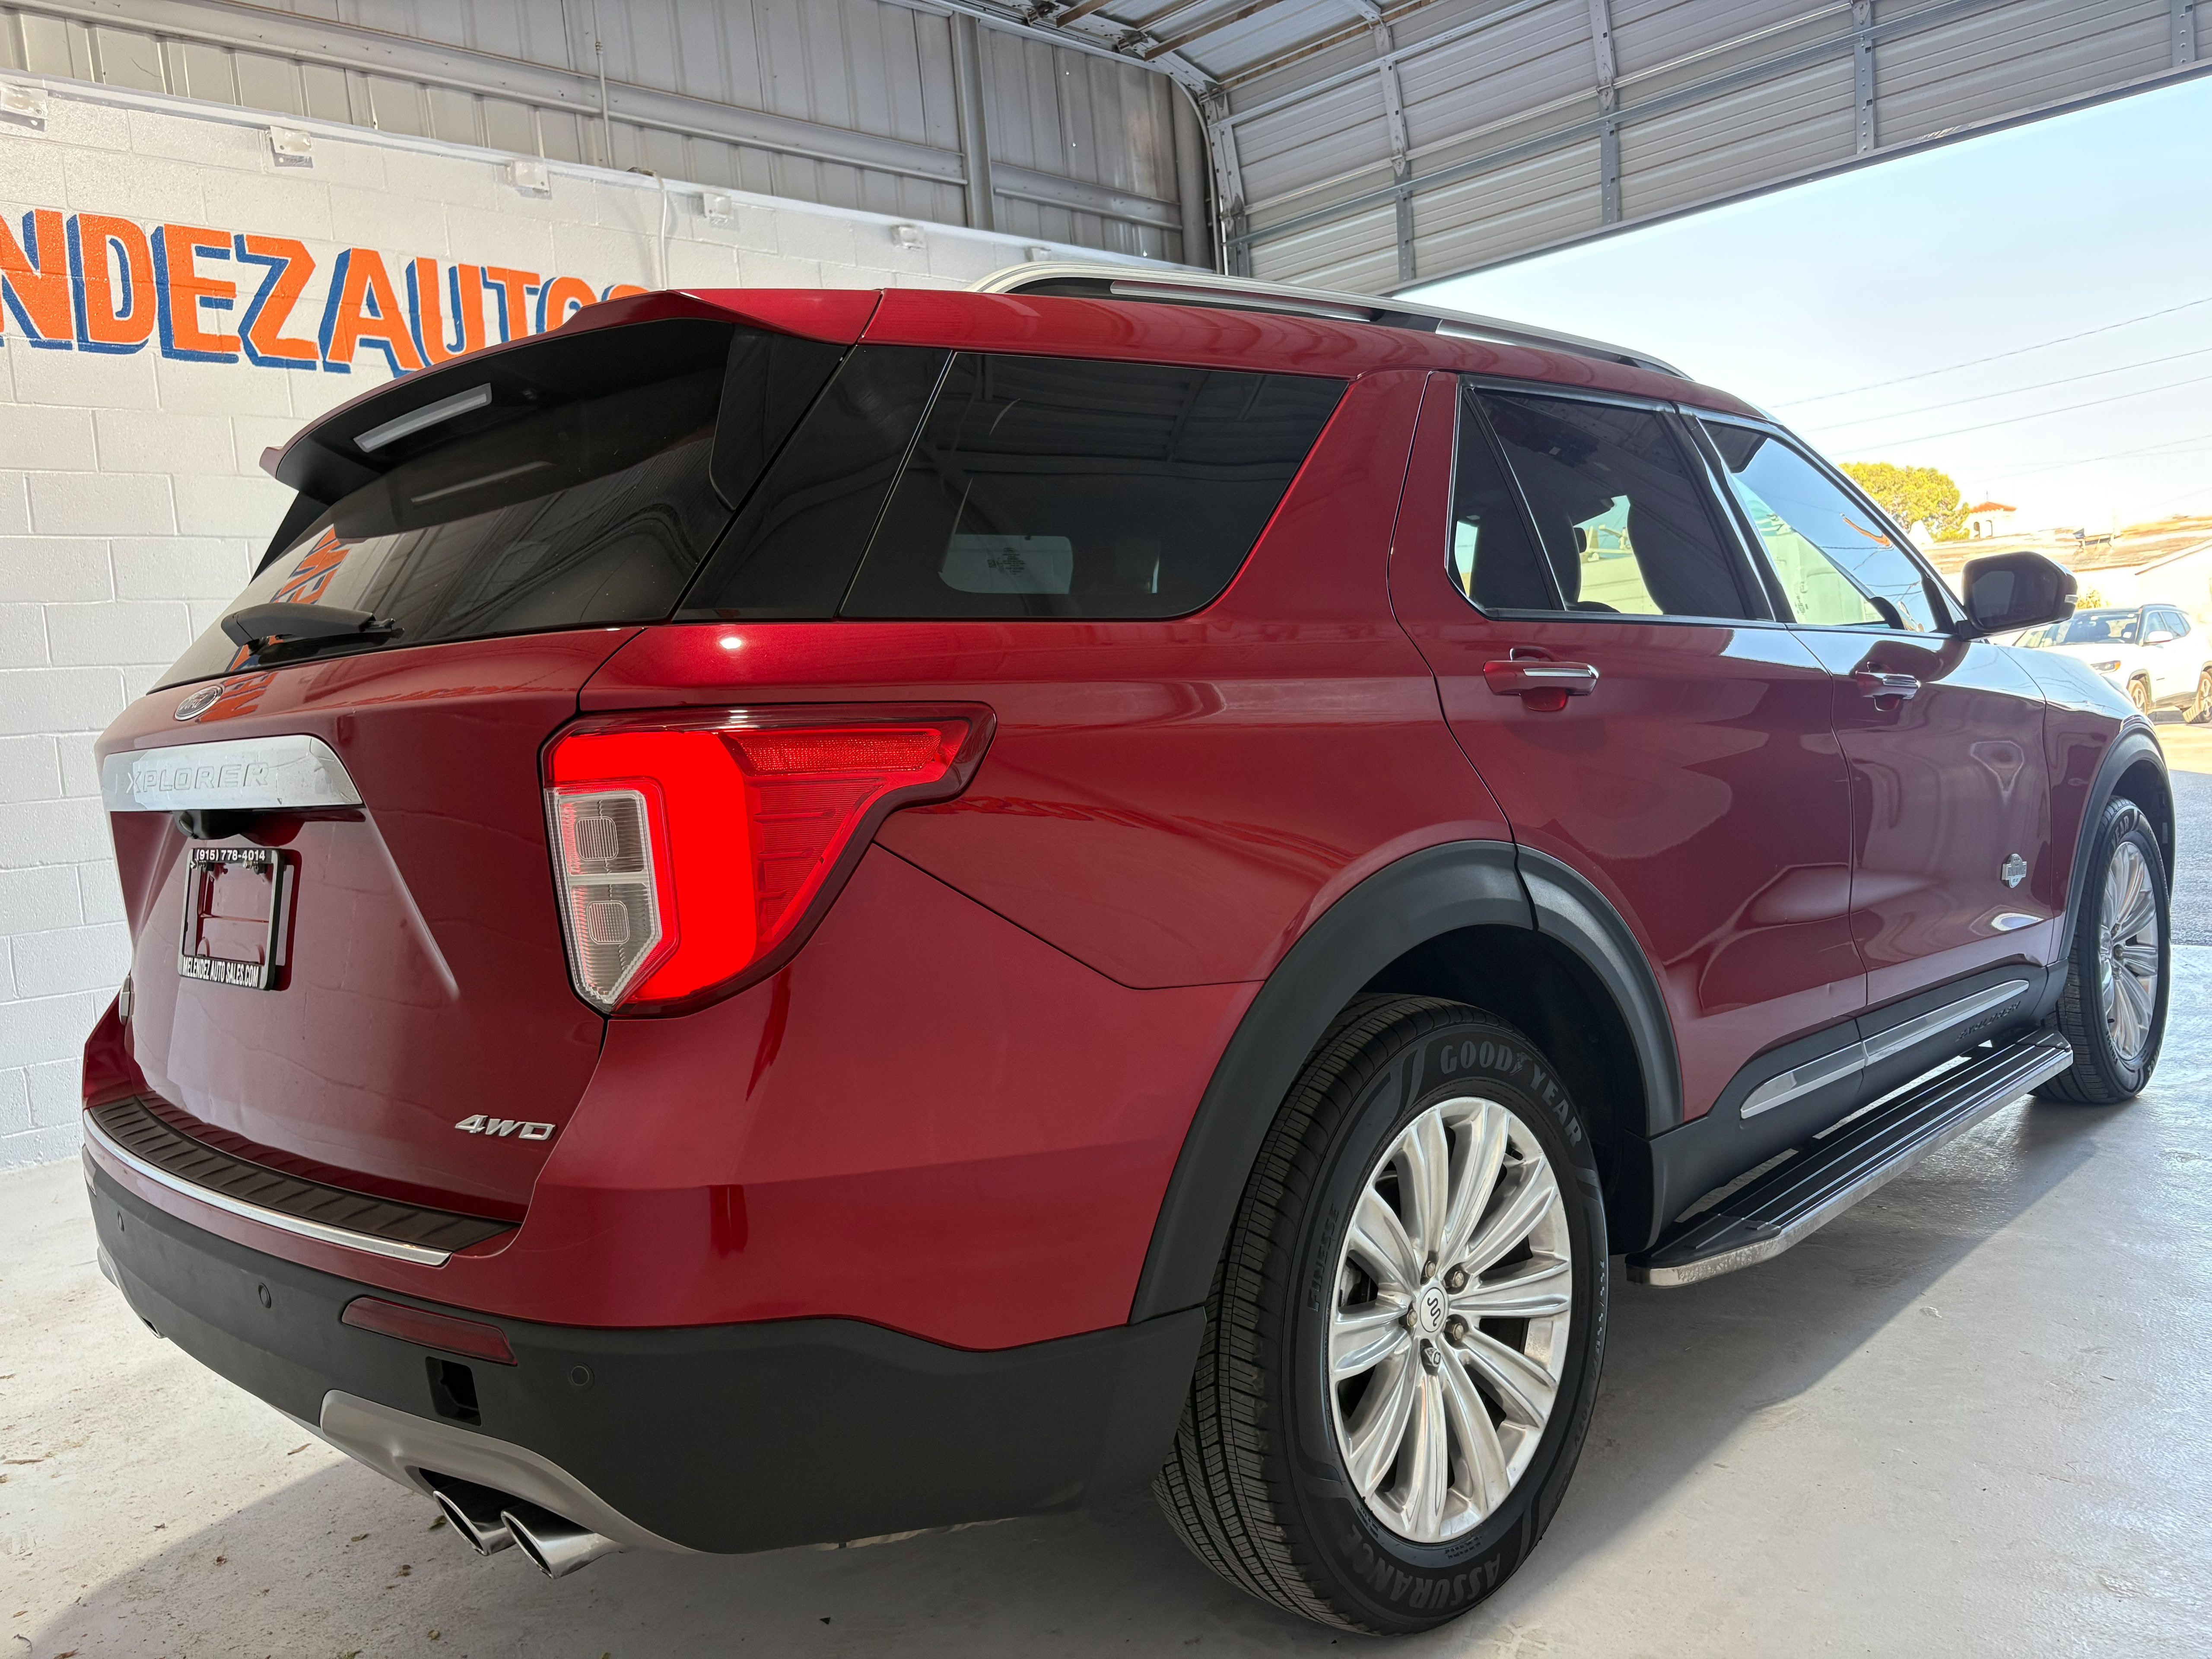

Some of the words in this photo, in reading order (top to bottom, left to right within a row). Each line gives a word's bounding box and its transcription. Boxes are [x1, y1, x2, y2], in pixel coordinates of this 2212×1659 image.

[197, 849, 219, 861] (915)
[221, 849, 265, 861] 778-4014
[182, 956, 210, 980] MELENDEZ
[210, 960, 225, 983] AUTO
[226, 962, 259, 987] SALES.COM
[455, 1114, 556, 1141] 4WD
[1341, 1524, 1501, 1609] ASSURANCE
